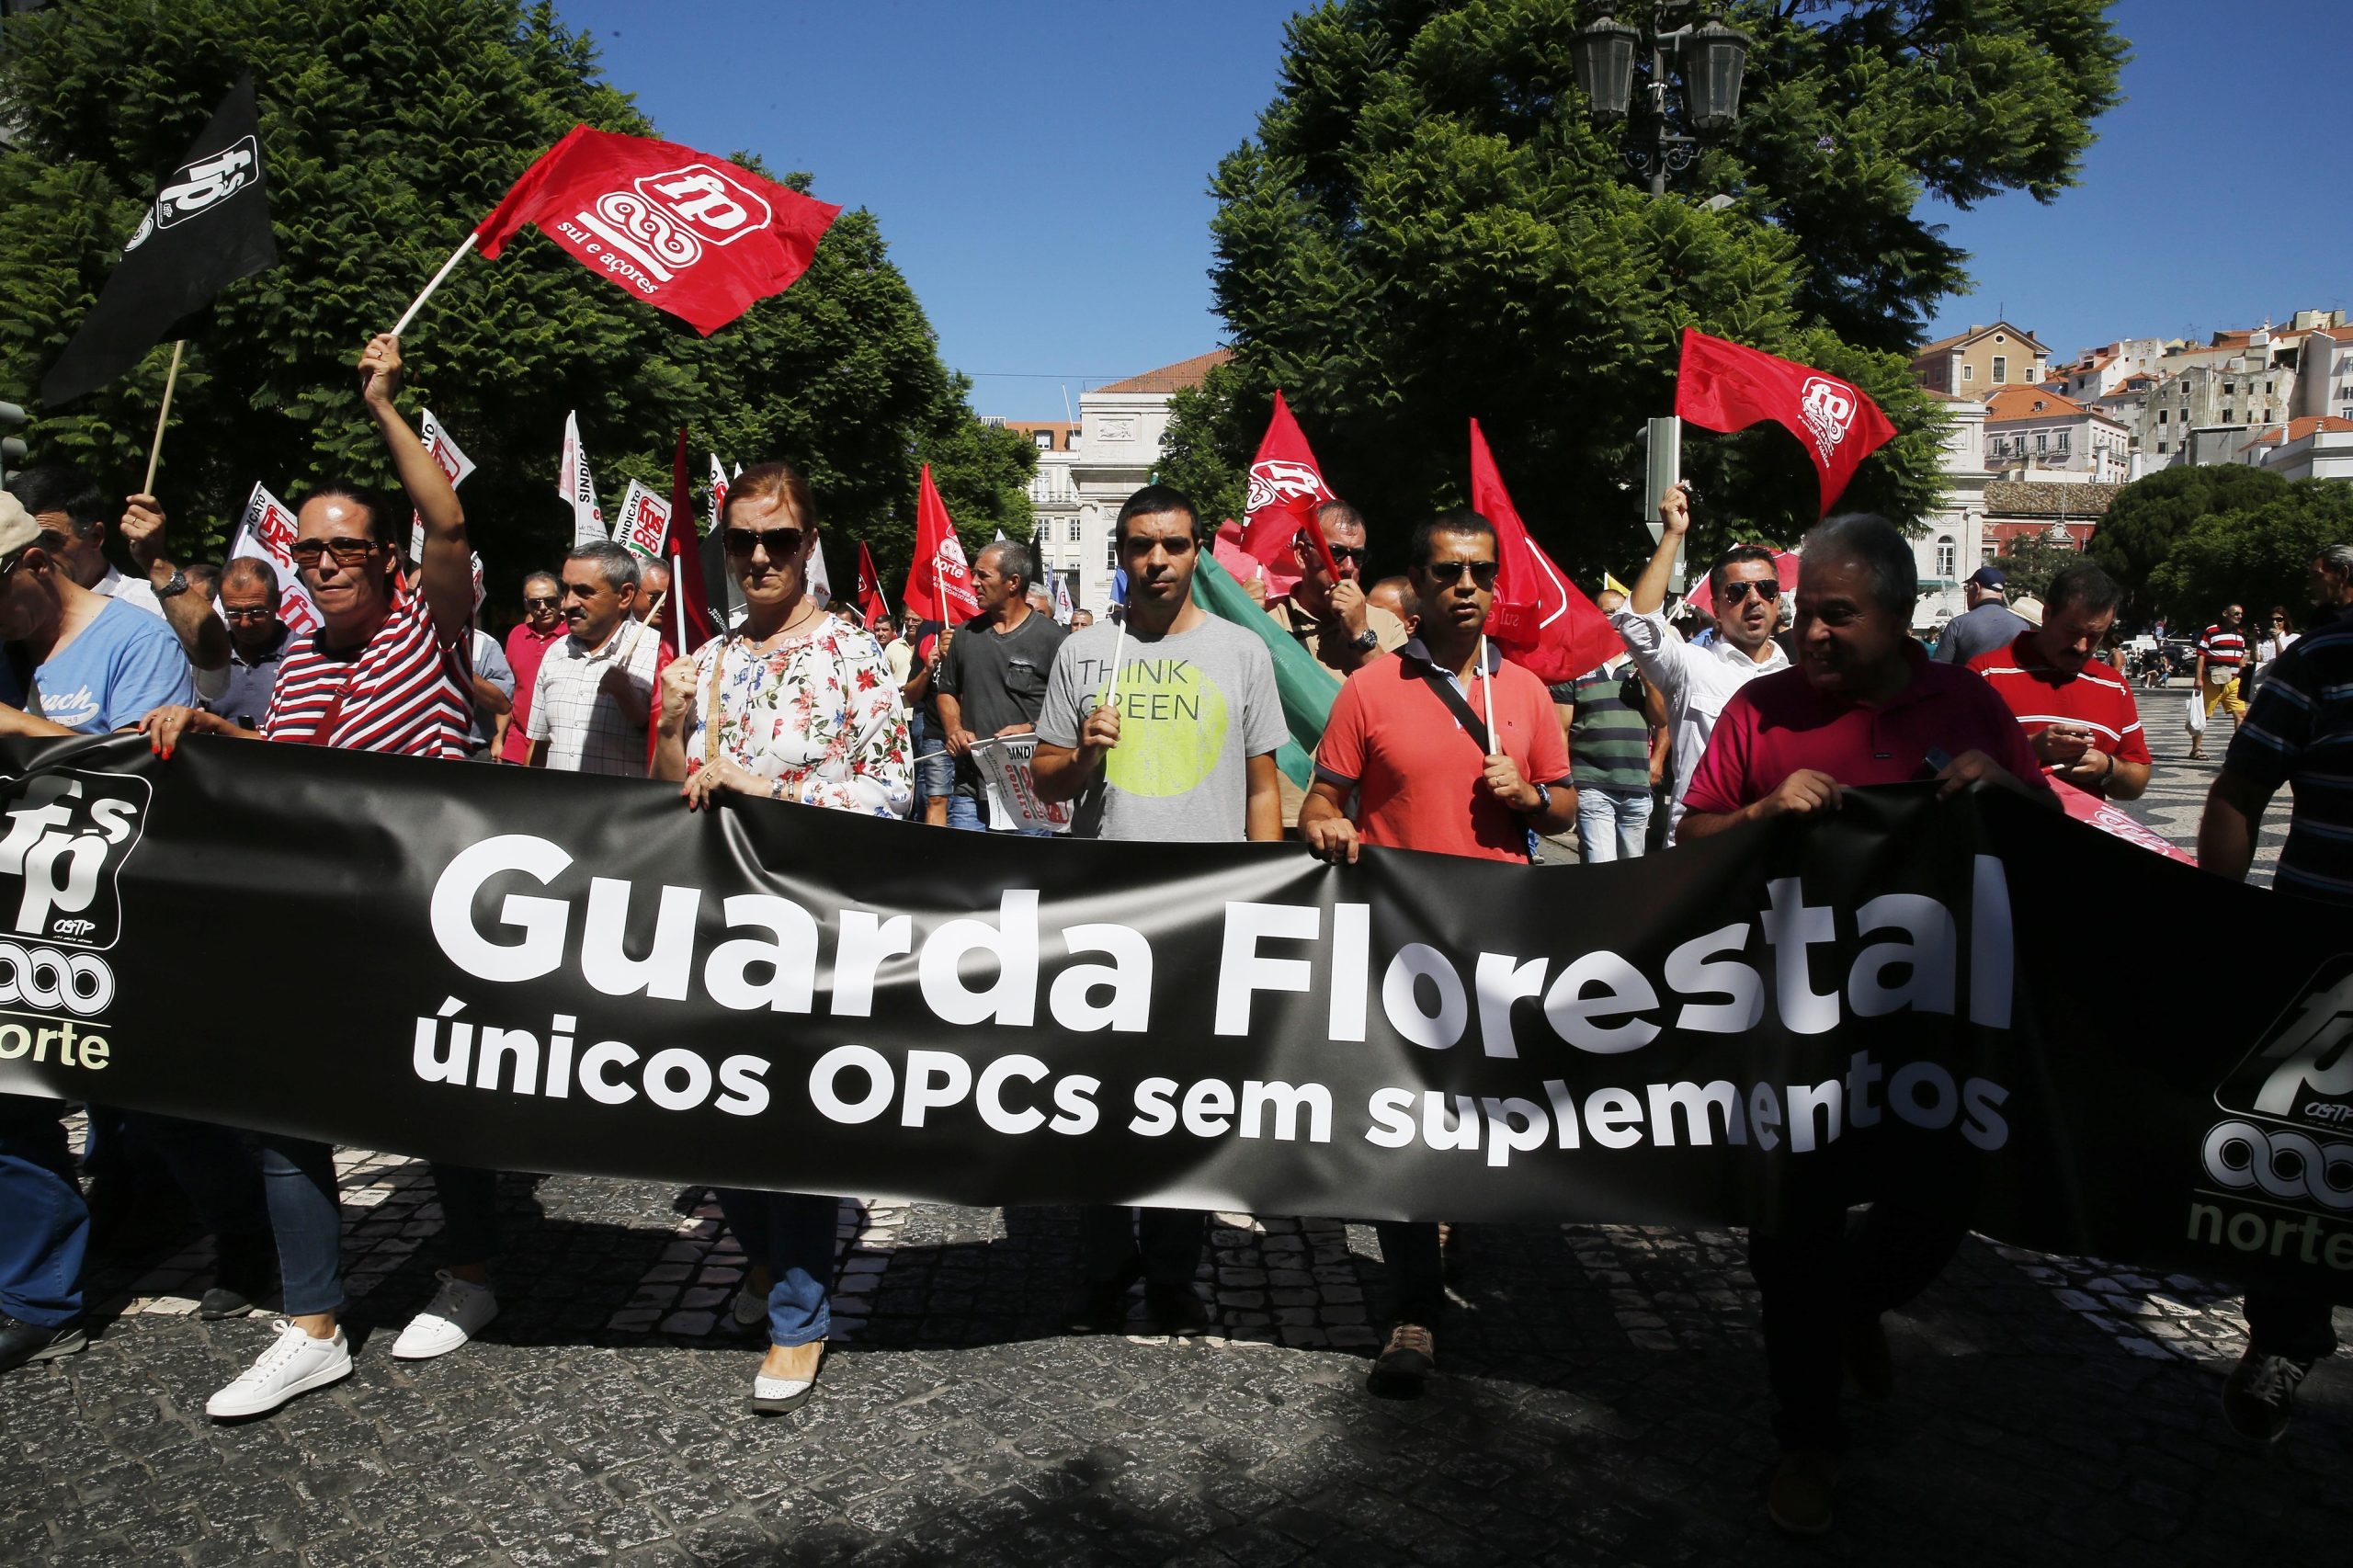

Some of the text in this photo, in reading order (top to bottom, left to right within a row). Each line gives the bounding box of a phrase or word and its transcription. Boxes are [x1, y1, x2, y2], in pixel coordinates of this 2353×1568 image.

[557, 221, 658, 294] sul e açores
[619, 490, 641, 546] SINDICATO
[1077, 658, 1189, 685] THINK
[430, 834, 2014, 1059] Guarda Florestal
[0, 1022, 110, 1070] orte
[413, 995, 2010, 1167] únicos OPCs sem suplementos
[2186, 1201, 2353, 1271] norte
